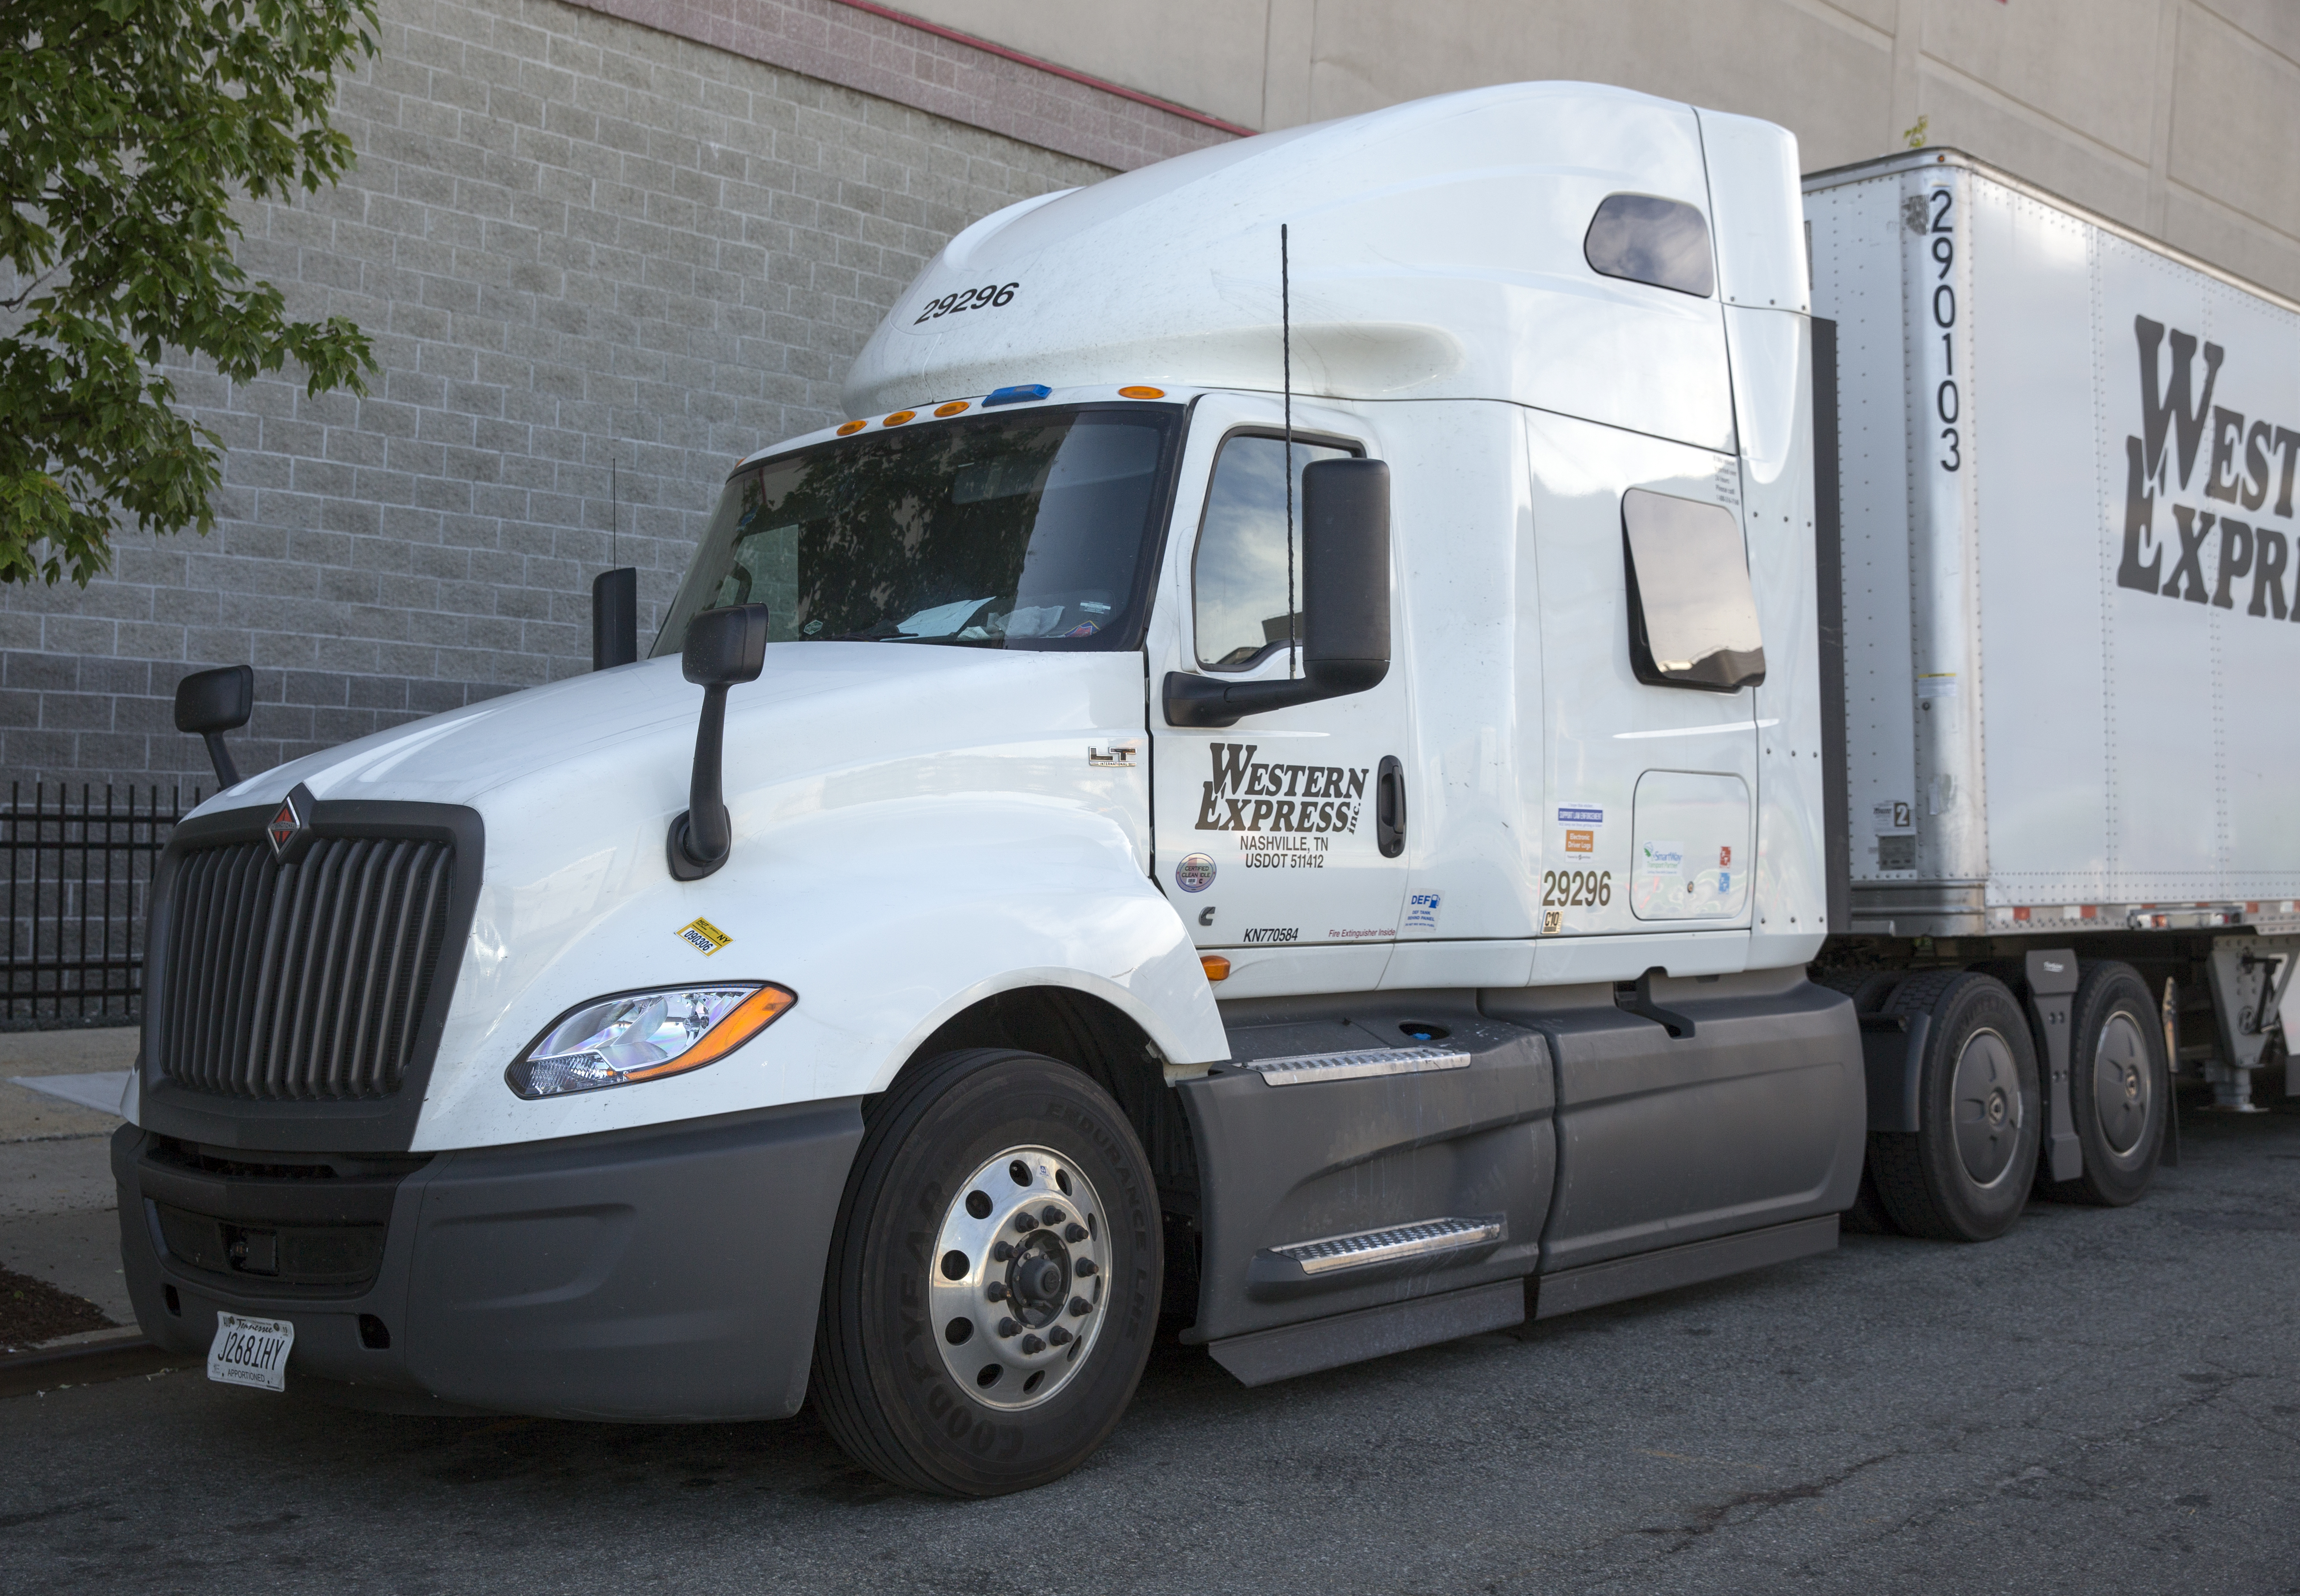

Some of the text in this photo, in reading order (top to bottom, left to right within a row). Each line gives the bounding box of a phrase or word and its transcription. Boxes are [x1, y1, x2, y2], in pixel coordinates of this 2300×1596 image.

[913, 282, 1019, 326] 29296
[1930, 190, 1960, 472] 290103
[2117, 434, 2300, 623] EXPR
[1089, 746, 1137, 761] LT
[1210, 742, 1369, 799] WESTERN
[1195, 781, 1351, 833] EXPRESS
[1896, 804, 1908, 825] 2
[1347, 802, 1361, 835] inc.
[1241, 835, 1328, 853] NASHVILLE, TN
[1246, 853, 1324, 868] USDOT 511412
[1655, 851, 1682, 864] SmartWay
[1542, 870, 1611, 907] 29296
[1411, 895, 1431, 905] DEF
[1545, 912, 1560, 926] C10
[684, 930, 713, 951] 090306
[716, 934, 731, 943] NY
[1243, 928, 1298, 942] KN770584
[1341, 929, 1377, 938] Extinguisher
[237, 1318, 273, 1333] Tennessee
[900, 1180, 1024, 1459] GOODYEAR
[218, 1331, 285, 1370] J2681HY
[227, 1369, 265, 1382] APPORTIONED
